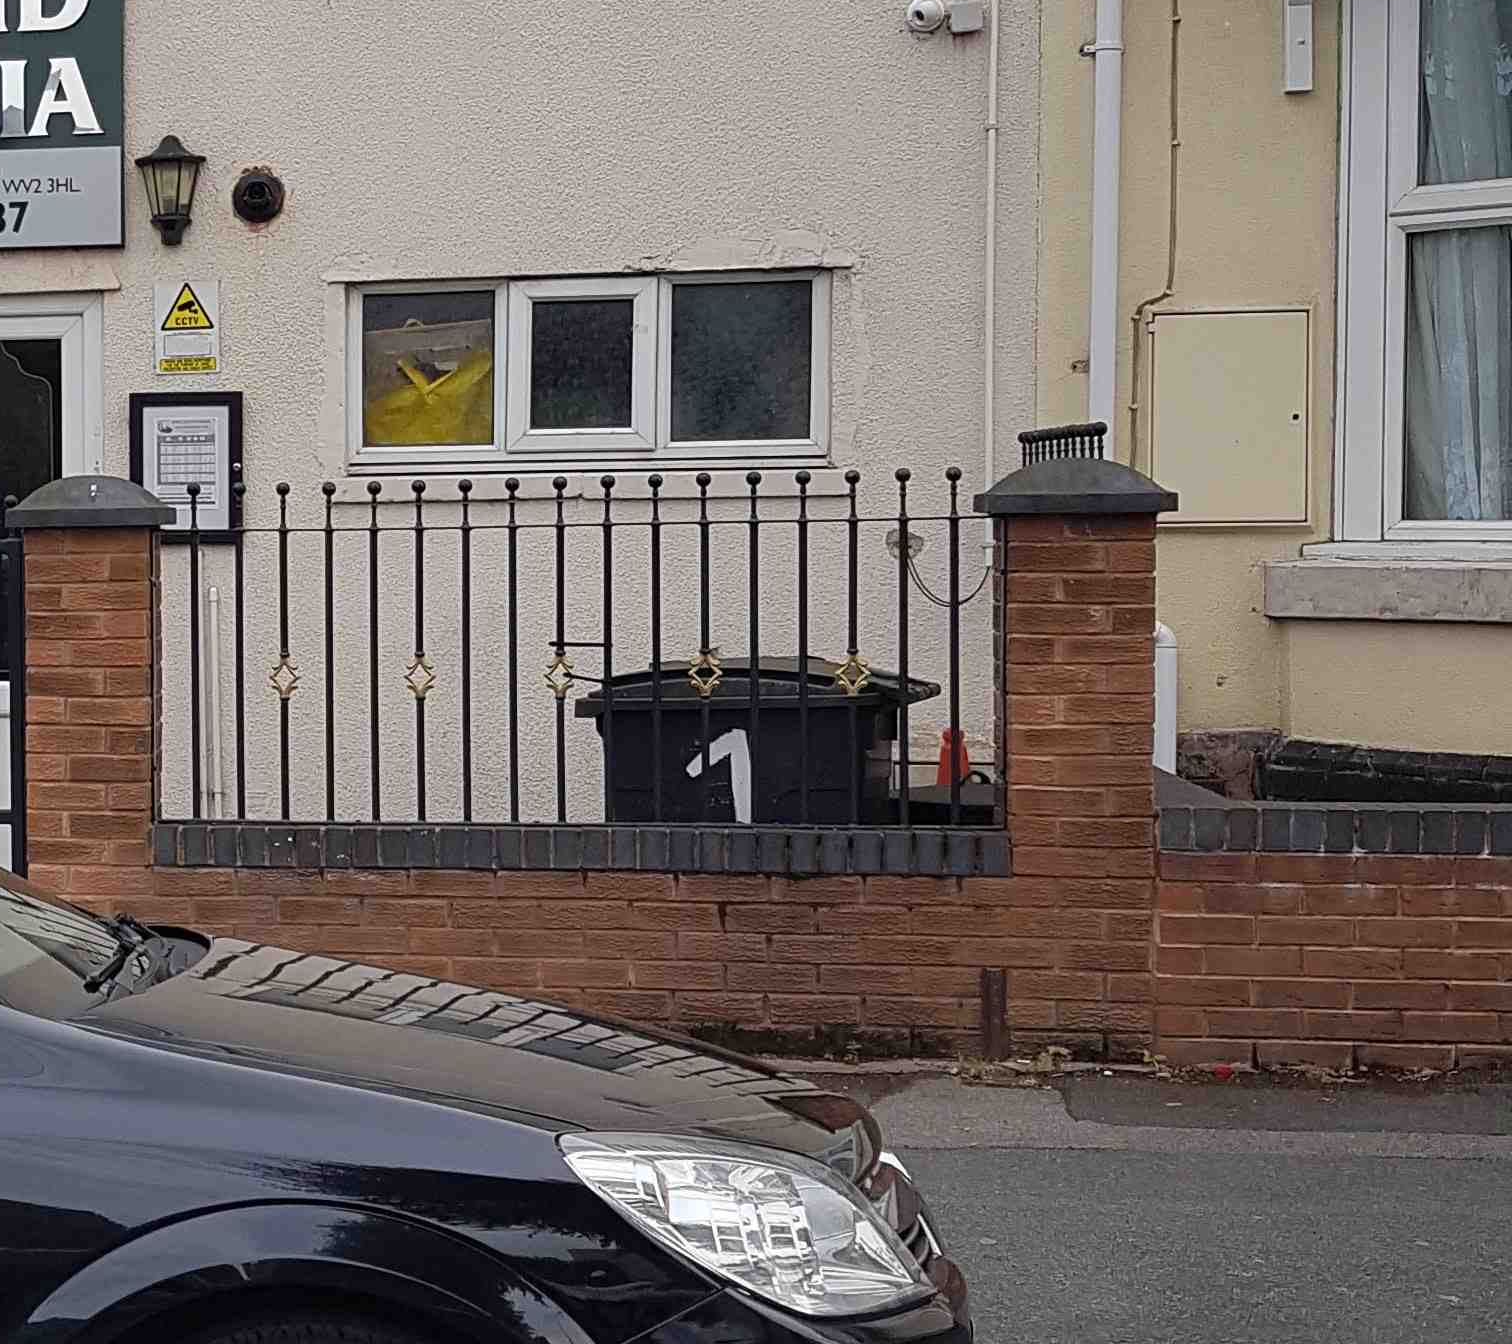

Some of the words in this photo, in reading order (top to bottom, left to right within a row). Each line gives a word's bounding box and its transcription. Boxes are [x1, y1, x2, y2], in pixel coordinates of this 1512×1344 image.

[2, 178, 42, 194] WV2
[46, 177, 81, 194] 3HL
[175, 316, 199, 326] CCTV
